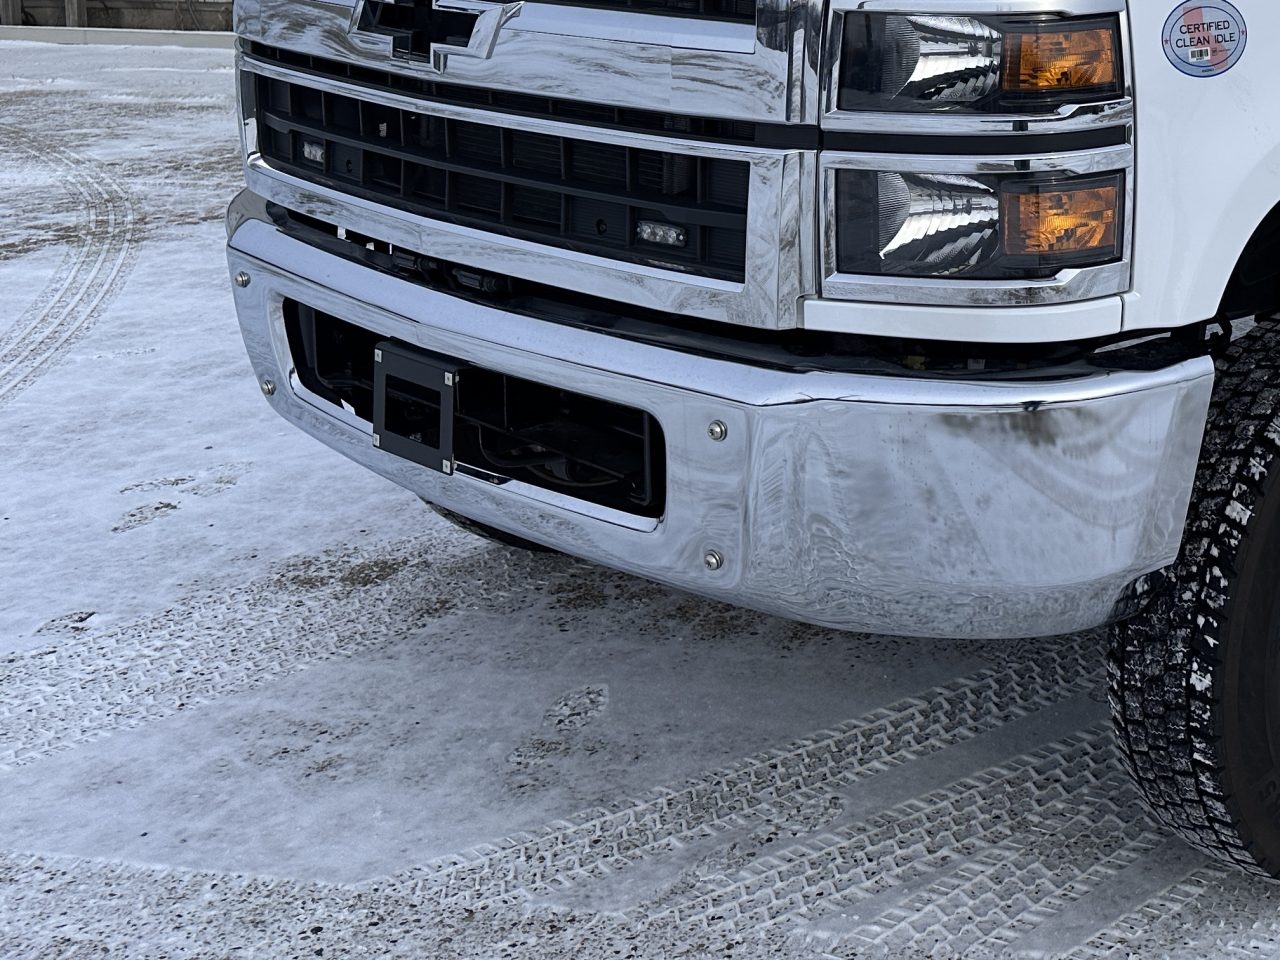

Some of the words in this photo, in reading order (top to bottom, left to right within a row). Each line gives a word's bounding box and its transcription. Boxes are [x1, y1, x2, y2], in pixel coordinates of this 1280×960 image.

[1179, 20, 1230, 34] CERTIFIED
[1175, 35, 1210, 48] CLEAN
[1214, 32, 1236, 43] IDLE
